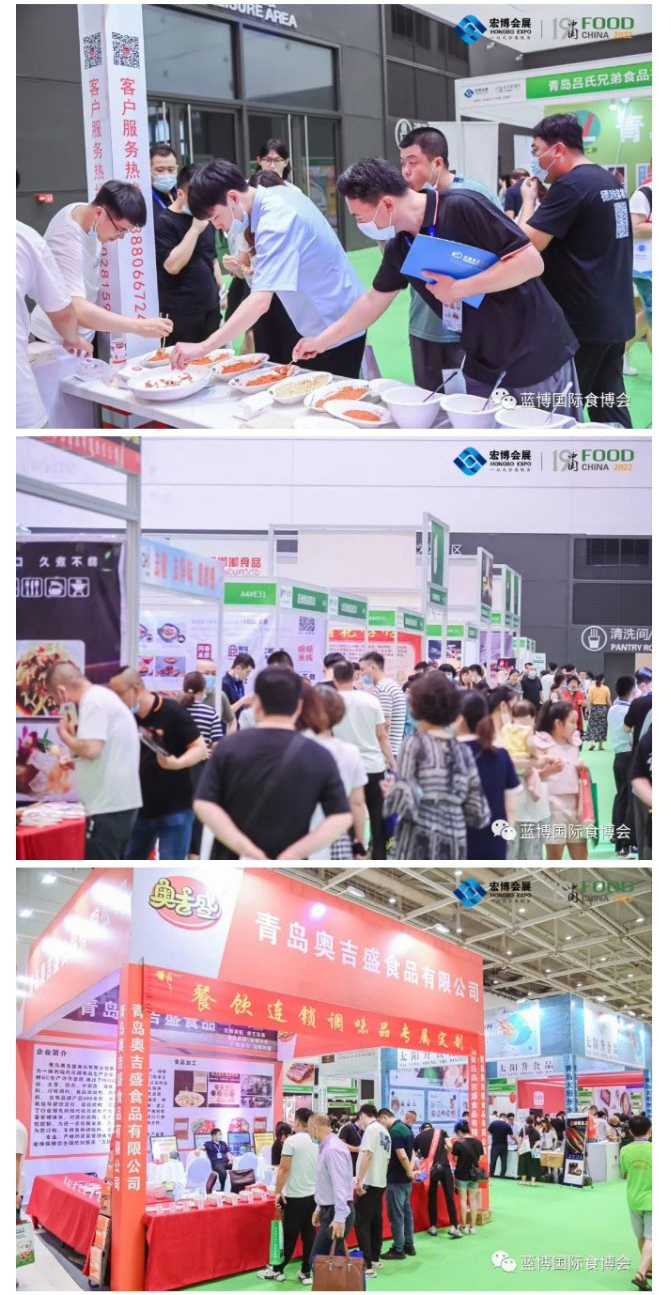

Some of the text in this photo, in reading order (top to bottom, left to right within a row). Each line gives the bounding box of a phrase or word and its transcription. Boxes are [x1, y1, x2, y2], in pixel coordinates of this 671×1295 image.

[216, 4, 297, 28] SURE AREA
[548, 69, 652, 92] 青岛吕氏兄弟食品
[120, 77, 140, 187] 客户服务热
[256, 912, 479, 1002] 青岛奥吉盛食品有限公司
[192, 983, 464, 1051] 餐饮连锁调味品专属定制
[127, 1004, 144, 1192] 青岛奥吉盛食品有限公司
